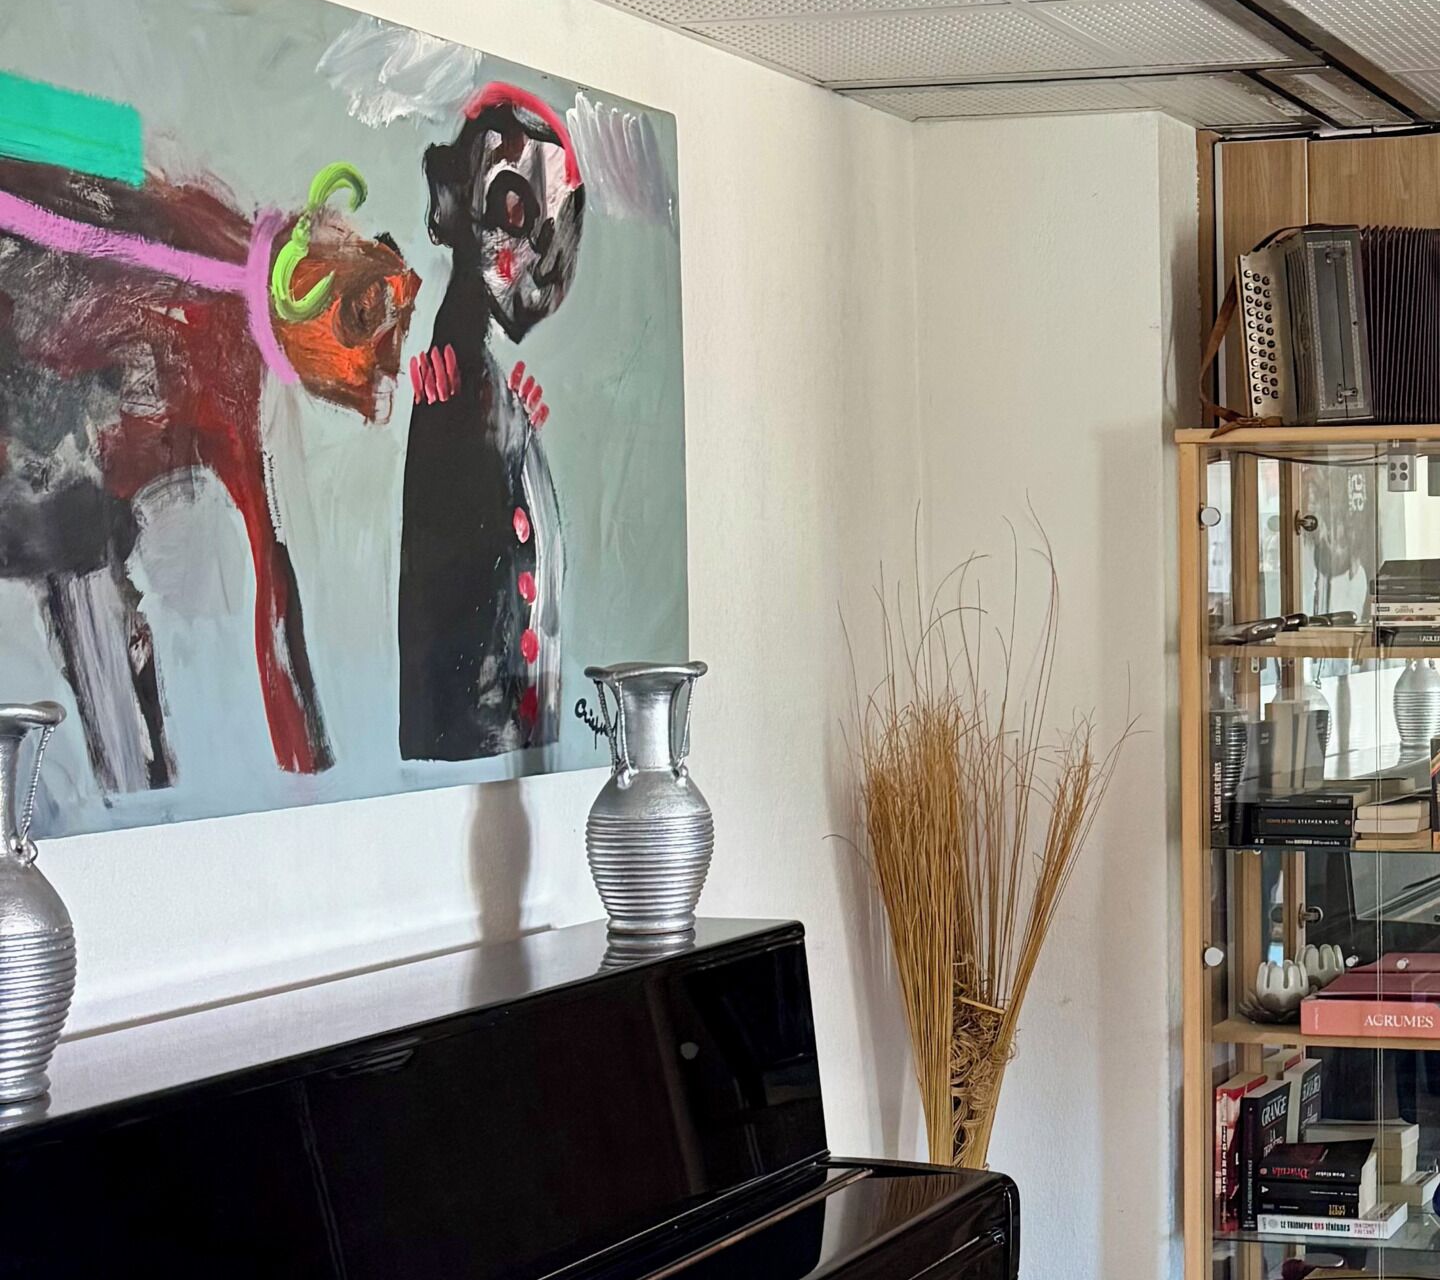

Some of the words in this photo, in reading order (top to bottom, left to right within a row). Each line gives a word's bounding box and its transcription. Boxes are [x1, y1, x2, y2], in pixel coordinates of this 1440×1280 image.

[1214, 814, 1221, 822] LE
[1364, 1014, 1434, 1028] AGRUMES
[1272, 1167, 1309, 1179] Dracula
[1287, 1221, 1313, 1230] TRIOMPHE
[1314, 1222, 1324, 1230] DES
